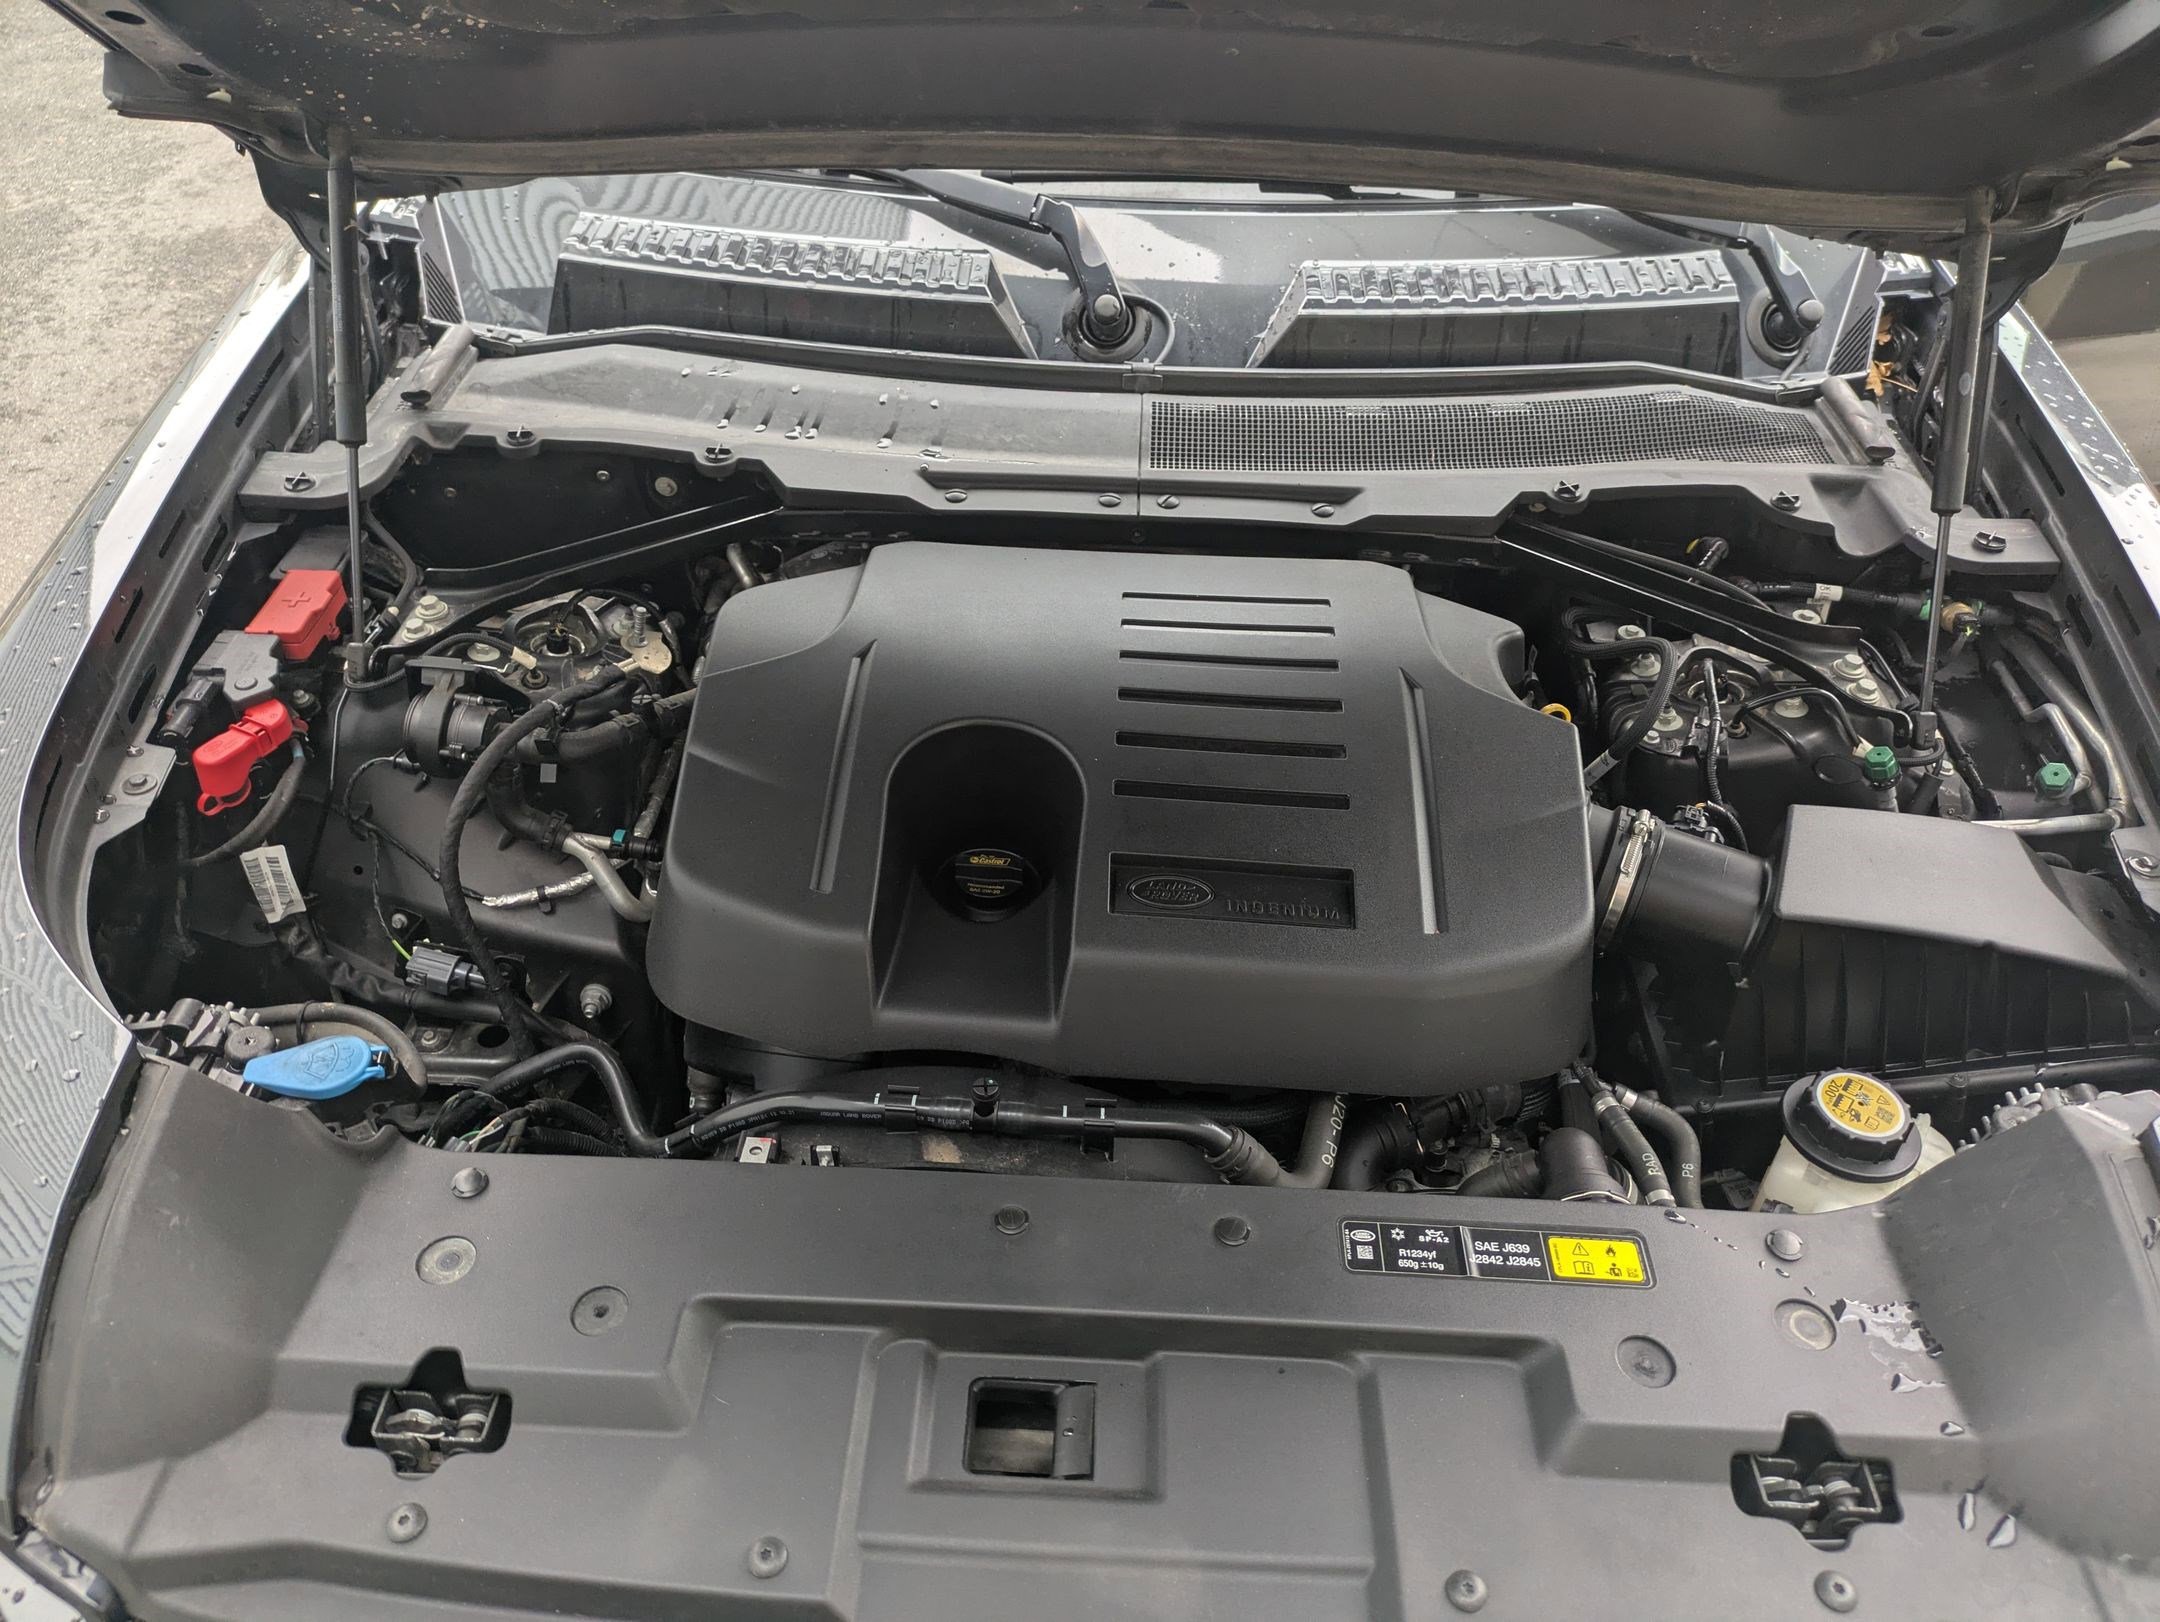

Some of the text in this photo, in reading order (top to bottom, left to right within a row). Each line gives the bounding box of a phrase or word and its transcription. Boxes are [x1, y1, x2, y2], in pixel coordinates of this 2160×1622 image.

[1227, 899, 1341, 920] INGENIUM
[1642, 1152, 1662, 1176] RAD
[1682, 1162, 1695, 1178] P6
[1418, 1235, 1450, 1243] SP-A2
[1474, 1241, 1531, 1254] SAE J639
[1398, 1249, 1437, 1260] R1234yf
[1469, 1253, 1542, 1267] J2842 J2845
[1397, 1259, 1419, 1269] 650g
